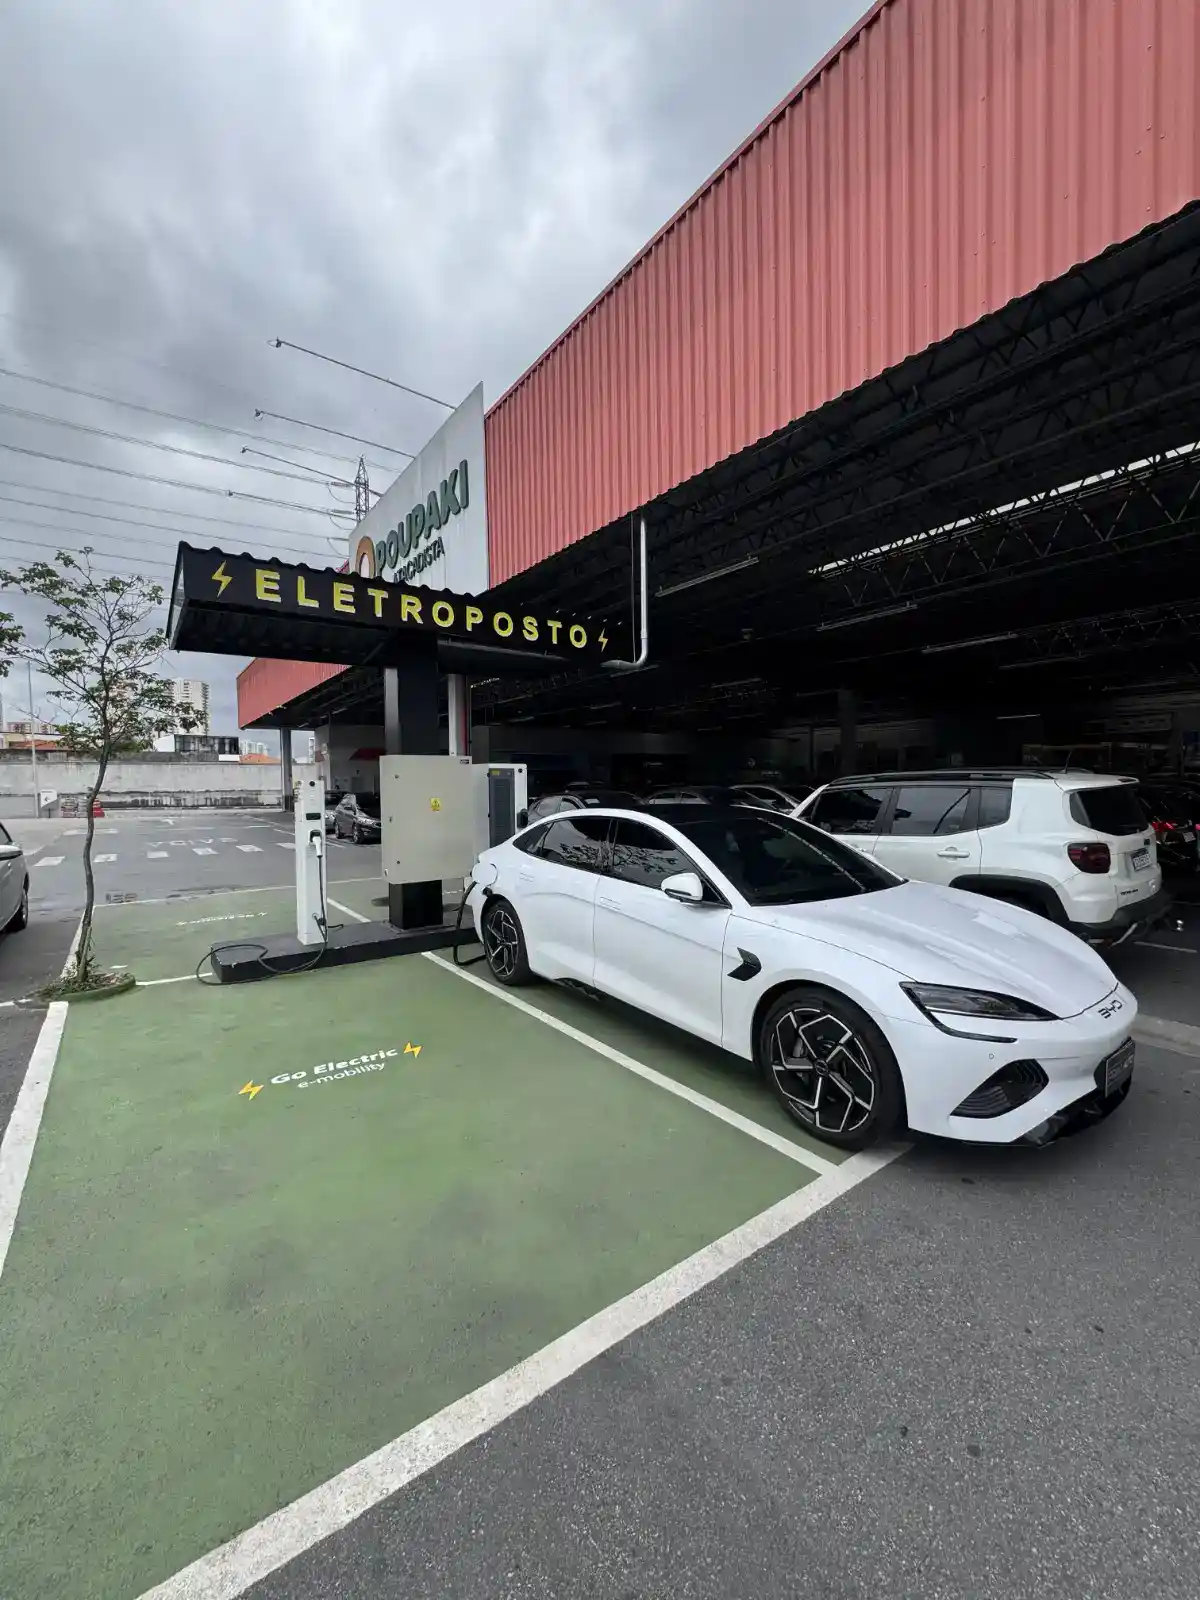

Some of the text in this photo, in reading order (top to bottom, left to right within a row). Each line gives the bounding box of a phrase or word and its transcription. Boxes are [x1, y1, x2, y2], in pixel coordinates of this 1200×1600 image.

[375, 459, 470, 578] POUPAKI
[393, 536, 445, 583] ATACADISTA
[255, 568, 588, 649] ELETROPOSTO
[1098, 999, 1123, 1019] BYD
[270, 1048, 399, 1085] Go Electric
[297, 1061, 386, 1089] e-mobility
